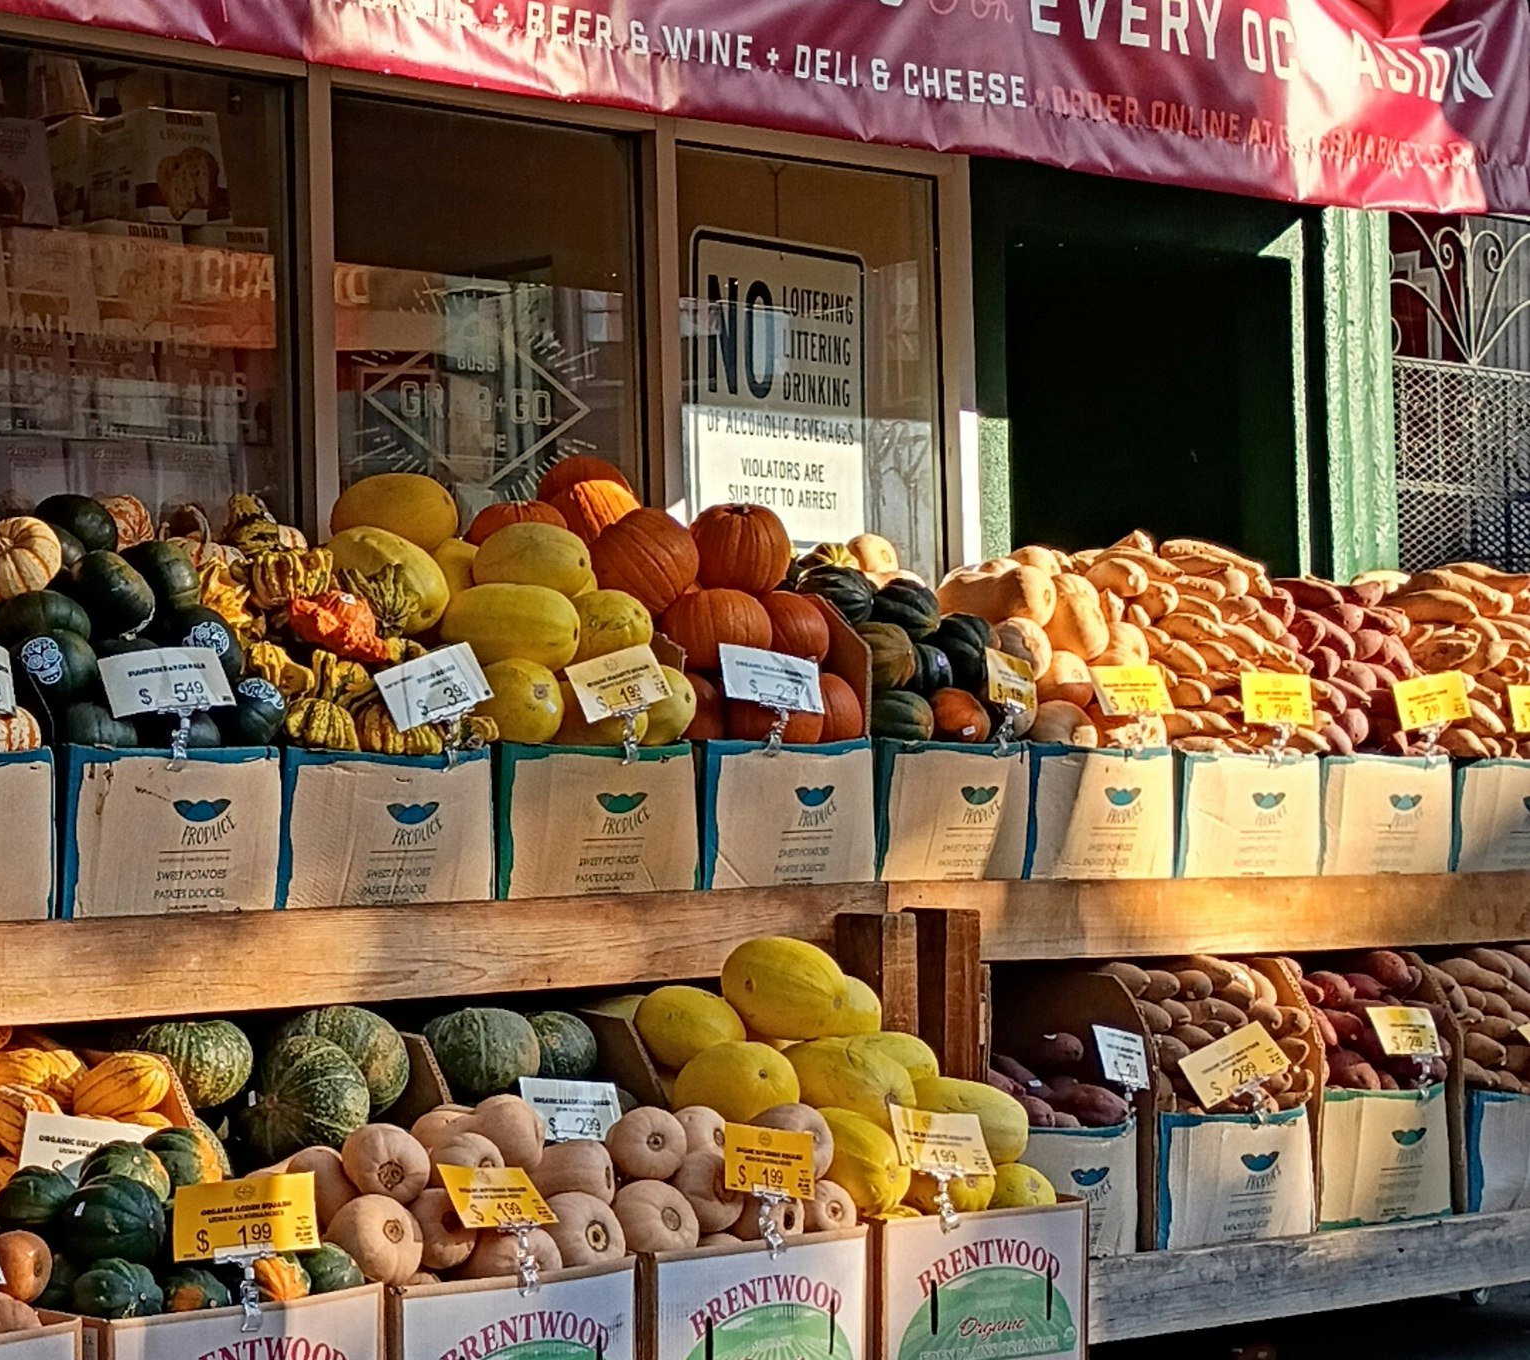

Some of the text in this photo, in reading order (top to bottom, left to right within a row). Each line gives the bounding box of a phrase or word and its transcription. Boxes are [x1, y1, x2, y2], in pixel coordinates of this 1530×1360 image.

[526, 1, 615, 50] BEER
[630, 20, 649, 55] &
[661, 26, 753, 70] WINE
[794, 44, 858, 87] DELI
[872, 58, 891, 92] &
[904, 63, 1027, 108] CHEESE
[1052, 86, 1140, 126] ORDER
[1151, 101, 1241, 142] ONLINE
[783, 286, 854, 325] LOITERING
[707, 274, 774, 399] NO
[783, 329, 850, 366] LITTERING
[399, 380, 552, 427] GRB GO
[783, 372, 850, 408] DRINKING
[707, 409, 854, 446] OF ALCOHOLIC BEVERAGES
[741, 457, 824, 483] VIOLATORS ARE
[728, 484, 837, 510] SUBJECT TO ARREST
[139, 688, 152, 706] $
[181, 814, 237, 846] PRODUCE
[602, 804, 651, 834] PRODUCE
[798, 803, 837, 827] PRODUCE
[392, 816, 444, 846] PRODUCE
[188, 887, 225, 898] DOUCES
[38, 1134, 75, 1146] ORGANIC
[738, 1165, 747, 1185] $
[200, 1206, 234, 1216] ORGANIC
[235, 1204, 260, 1213] ACORN
[196, 1230, 210, 1254] $
[917, 1238, 1060, 1298] BRENTWOOD
[690, 1275, 842, 1340] BRENTWOOD
[959, 1316, 1026, 1337] Organic
